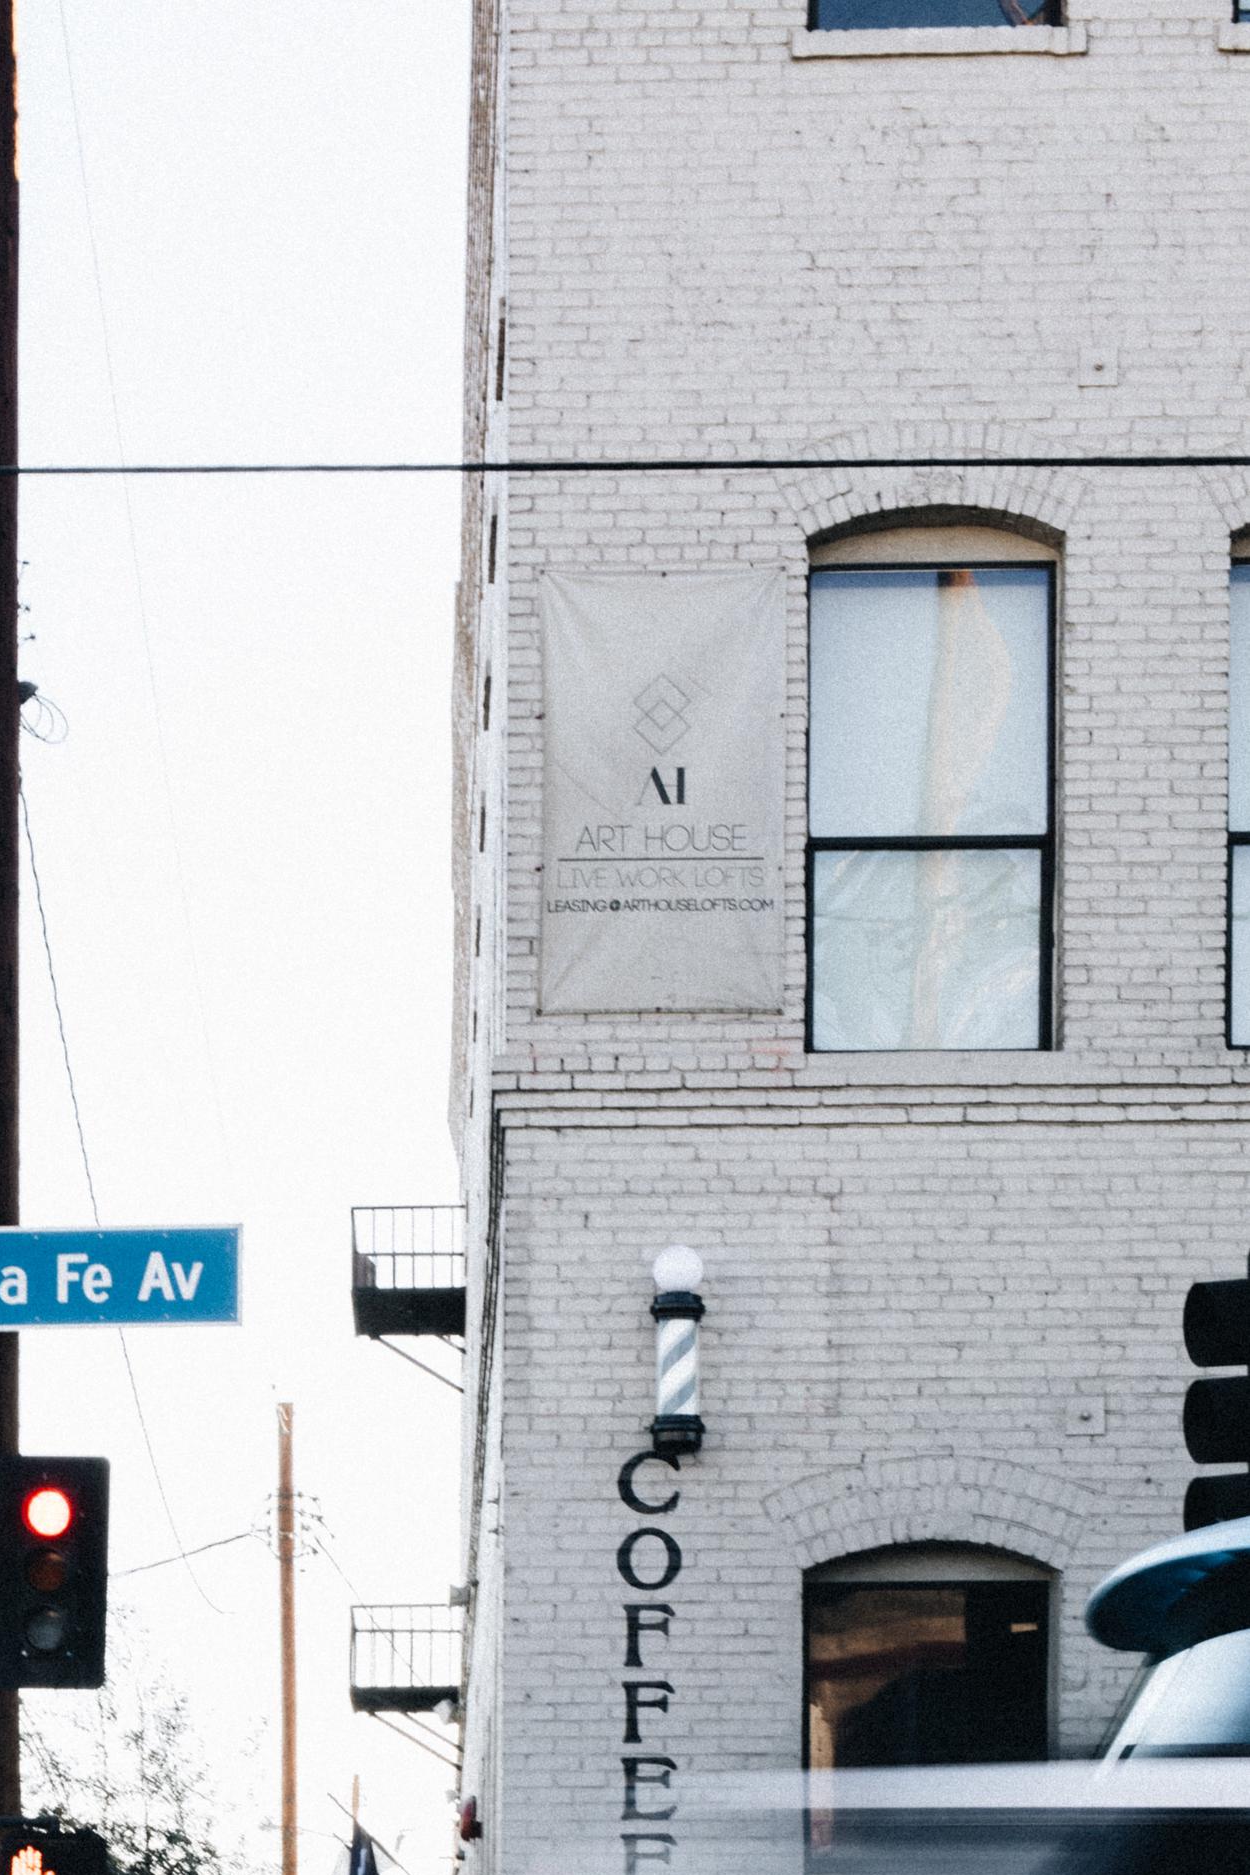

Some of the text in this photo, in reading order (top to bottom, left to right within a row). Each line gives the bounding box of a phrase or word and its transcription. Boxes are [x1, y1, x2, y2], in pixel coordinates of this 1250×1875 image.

[575, 824, 749, 852] ART HOUSE
[556, 865, 766, 889] LIVE WORK LOFTS
[55, 1253, 113, 1304] Fe
[137, 1251, 204, 1302] Av
